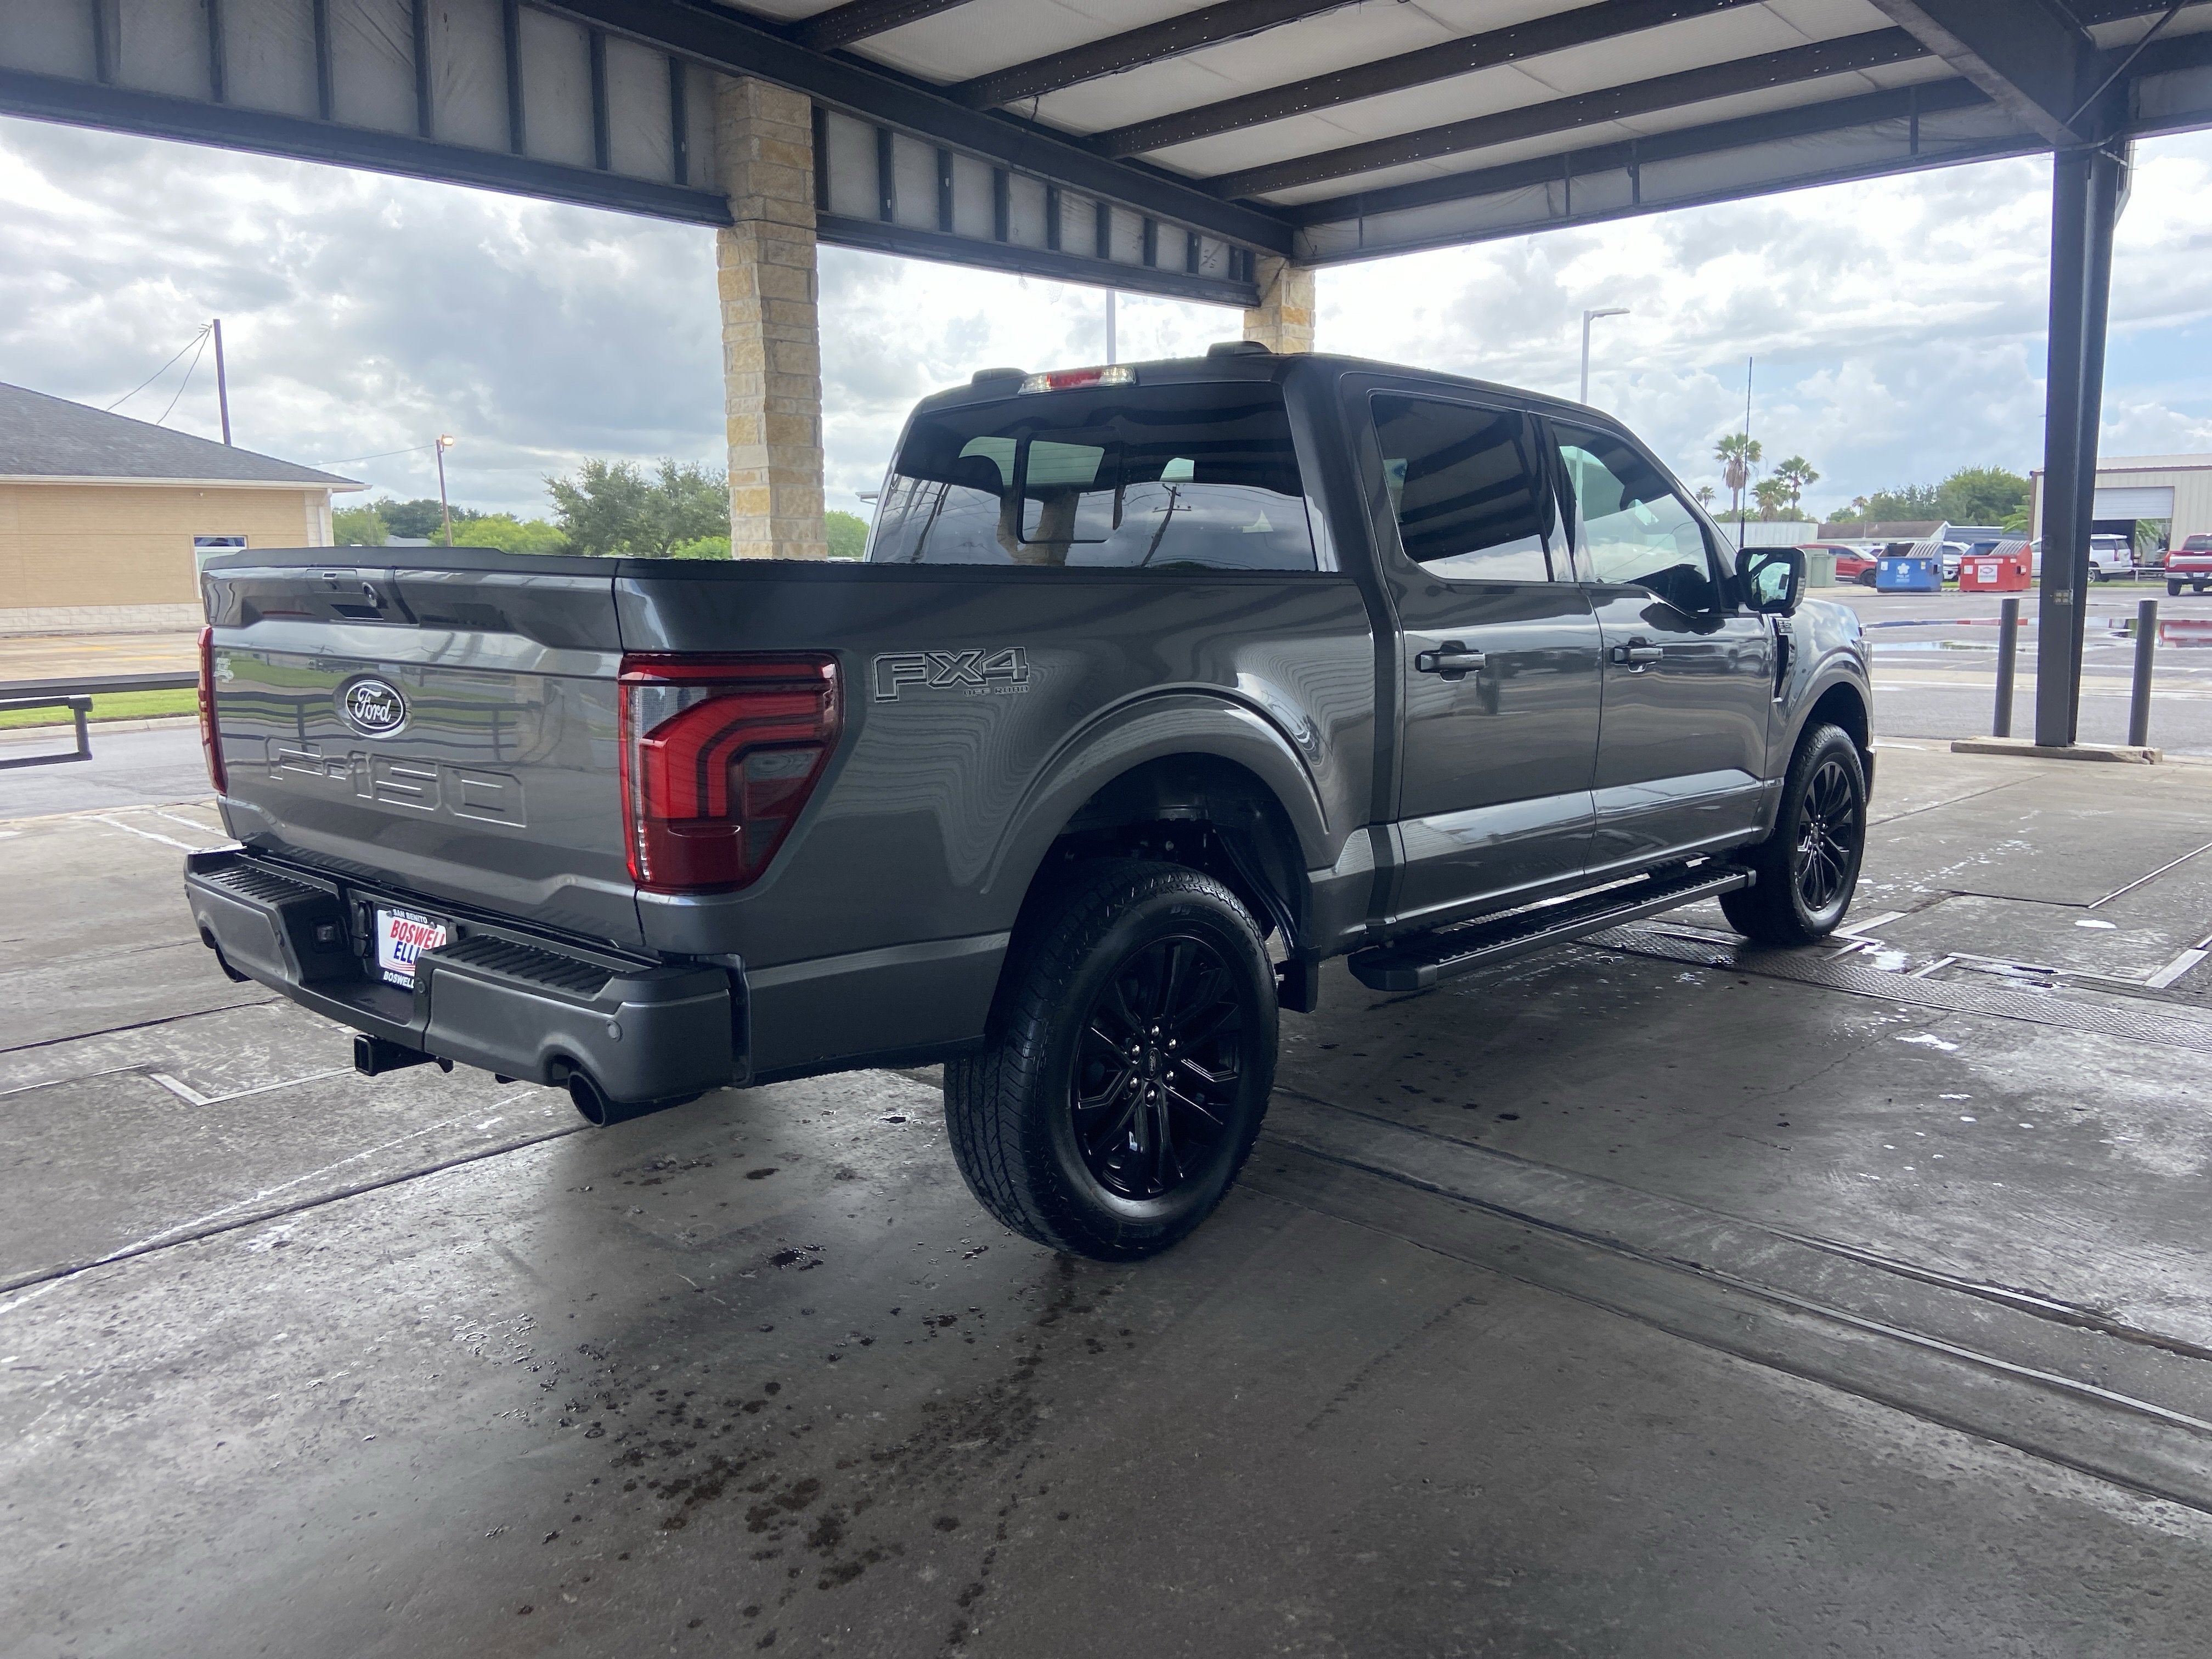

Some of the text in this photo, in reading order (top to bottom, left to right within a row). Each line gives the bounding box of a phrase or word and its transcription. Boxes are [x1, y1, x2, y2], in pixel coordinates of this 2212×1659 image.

[872, 647, 1030, 703] FX4
[354, 687, 392, 723] Ford
[392, 909, 428, 924] SAN BENITO
[383, 970, 415, 989] BOSWELL
